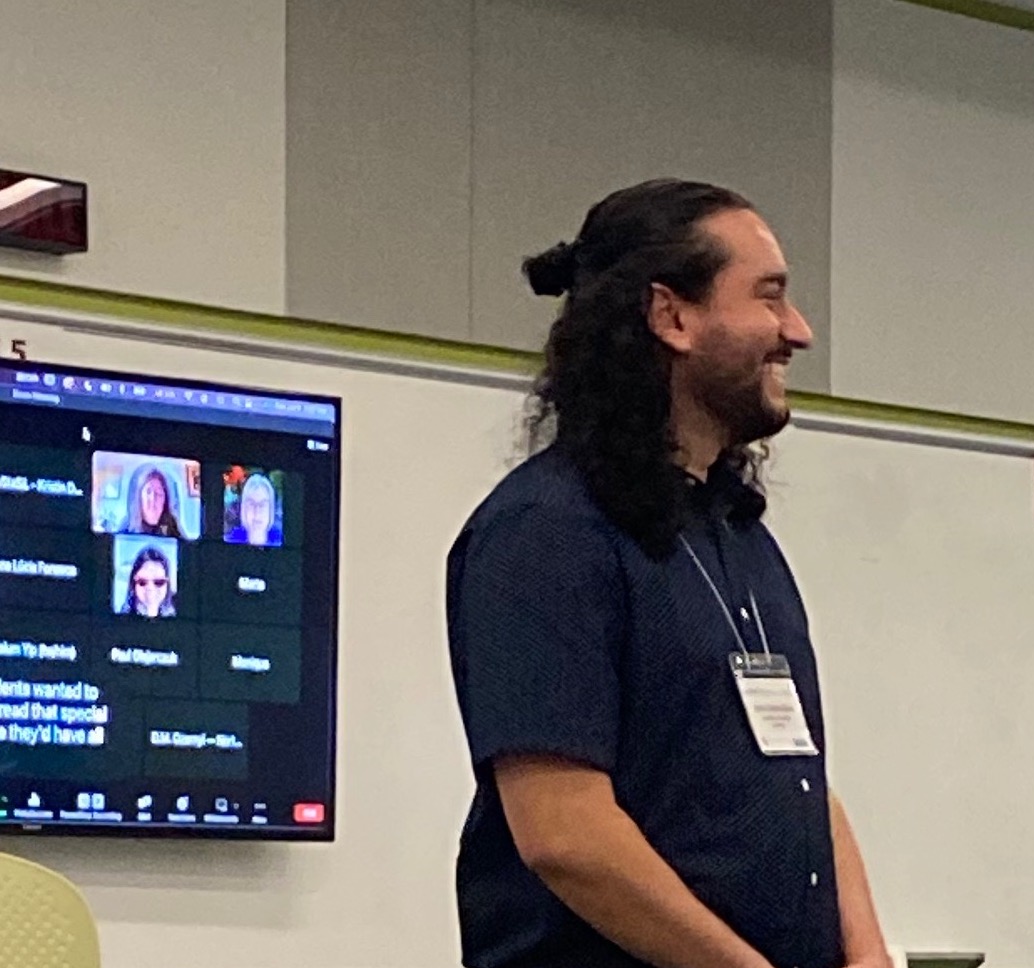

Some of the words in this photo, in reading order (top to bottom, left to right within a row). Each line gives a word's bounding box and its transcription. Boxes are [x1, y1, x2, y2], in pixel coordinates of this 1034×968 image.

[32, 681, 82, 700] wanted
[84, 683, 99, 701] to
[31, 702, 58, 721] that
[60, 704, 108, 725] special
[9, 722, 51, 746] they'd
[53, 724, 85, 744] have
